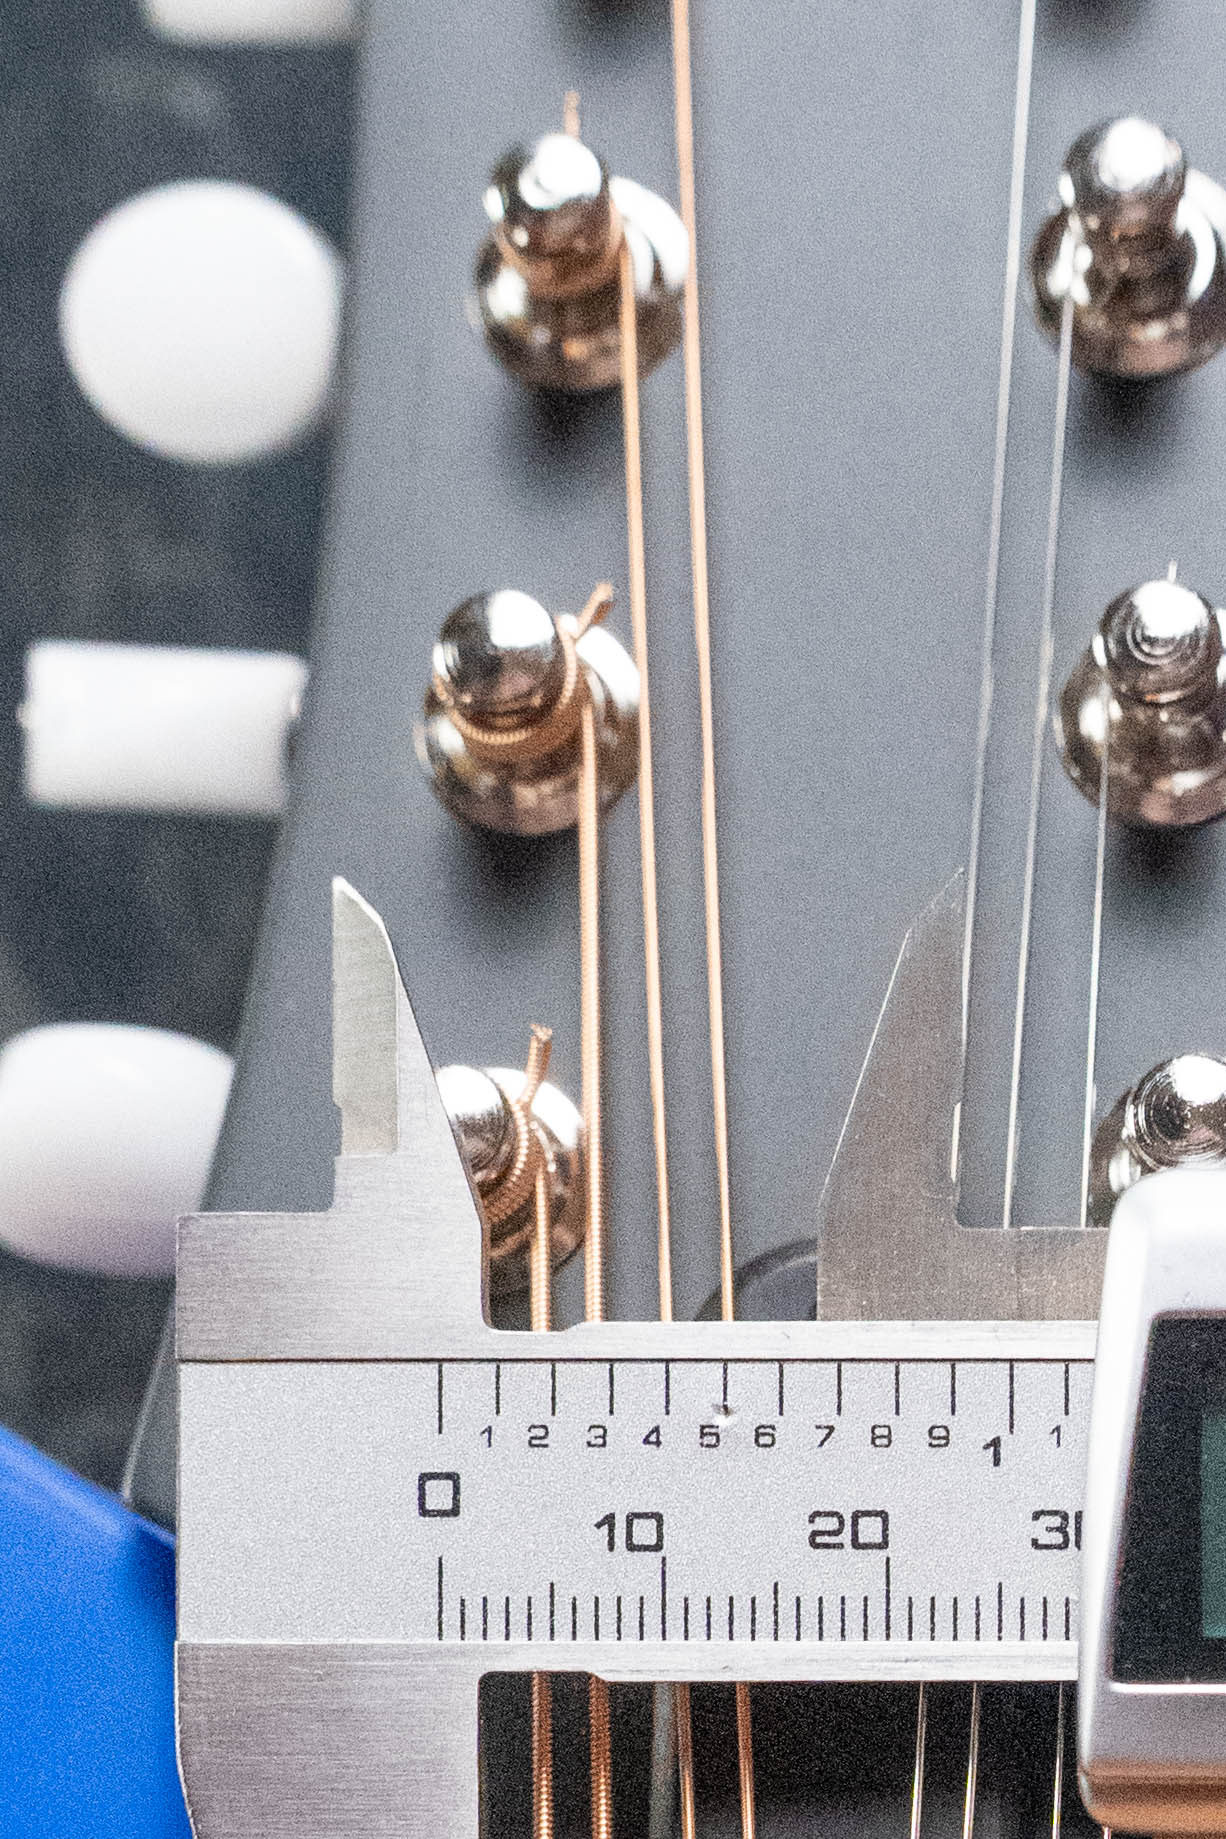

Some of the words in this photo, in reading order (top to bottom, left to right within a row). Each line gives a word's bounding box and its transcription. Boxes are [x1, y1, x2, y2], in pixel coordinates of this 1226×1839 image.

[480, 1425, 494, 1448] 1
[527, 1424, 550, 1449] 2
[586, 1424, 609, 1448] 3
[642, 1424, 663, 1448] 4
[699, 1424, 721, 1449] 5
[754, 1424, 777, 1449] 6
[814, 1424, 836, 1448] 7
[870, 1424, 893, 1449] 8
[927, 1424, 950, 1449] 9
[982, 1435, 1002, 1468] 1
[1050, 1424, 1062, 1448] 1
[417, 1471, 461, 1519] 0
[593, 1511, 665, 1553] 10
[807, 1509, 890, 1551] 20
[1030, 1509, 1084, 1551] 3
